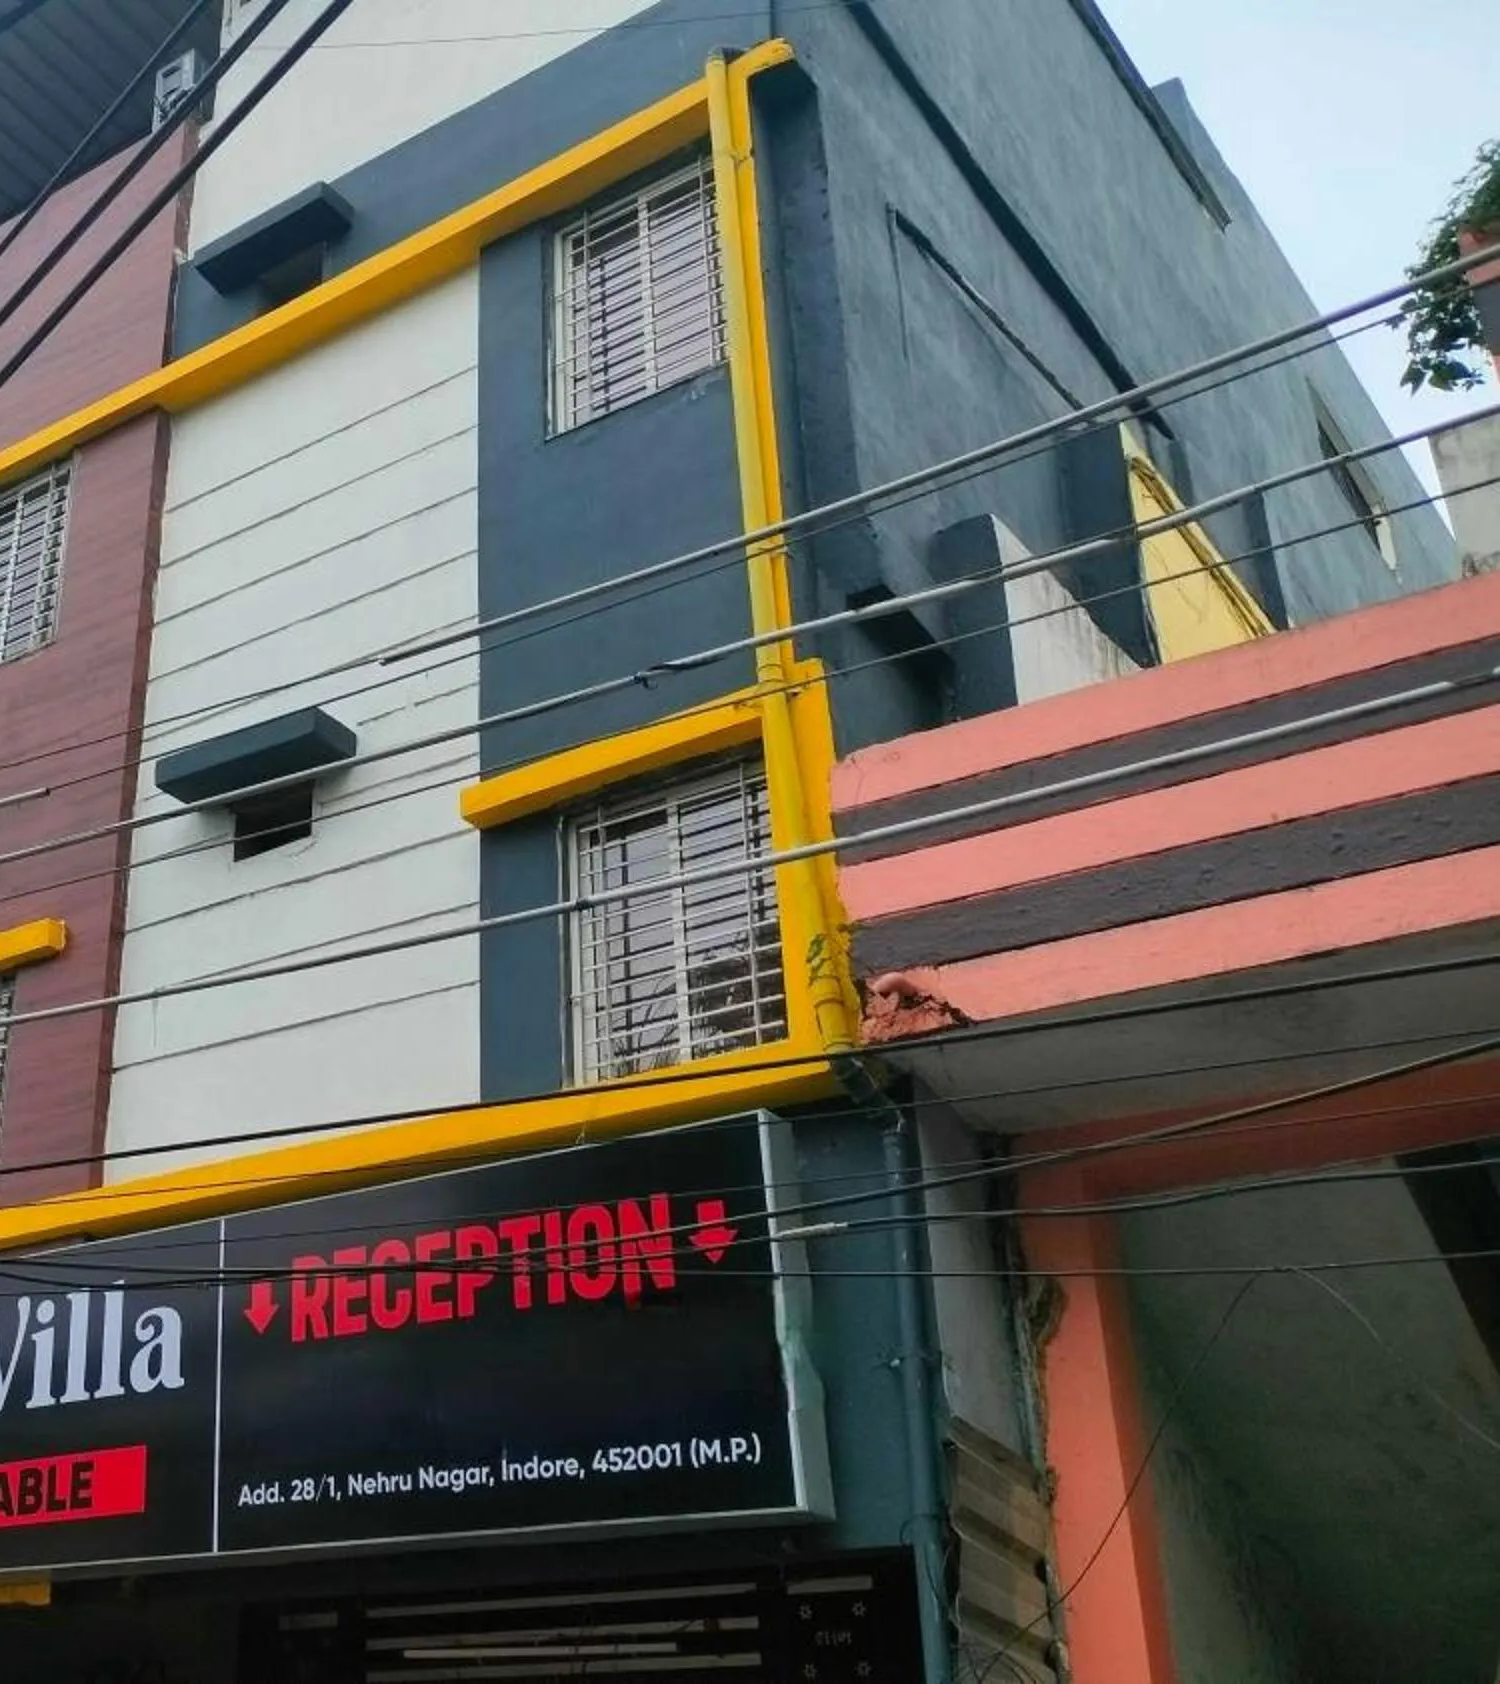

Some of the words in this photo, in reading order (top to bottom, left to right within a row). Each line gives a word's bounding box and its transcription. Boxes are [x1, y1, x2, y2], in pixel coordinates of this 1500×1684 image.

[291, 1193, 676, 1342] RECEPTION
[238, 1482, 285, 1507] Add.
[290, 1474, 342, 1502] 28/1,
[347, 1471, 412, 1497] Nehru
[418, 1465, 495, 1493] Nagar,
[501, 1455, 586, 1481] Indore,
[591, 1442, 682, 1473] 452001
[690, 1432, 761, 1468] (M.P.)
